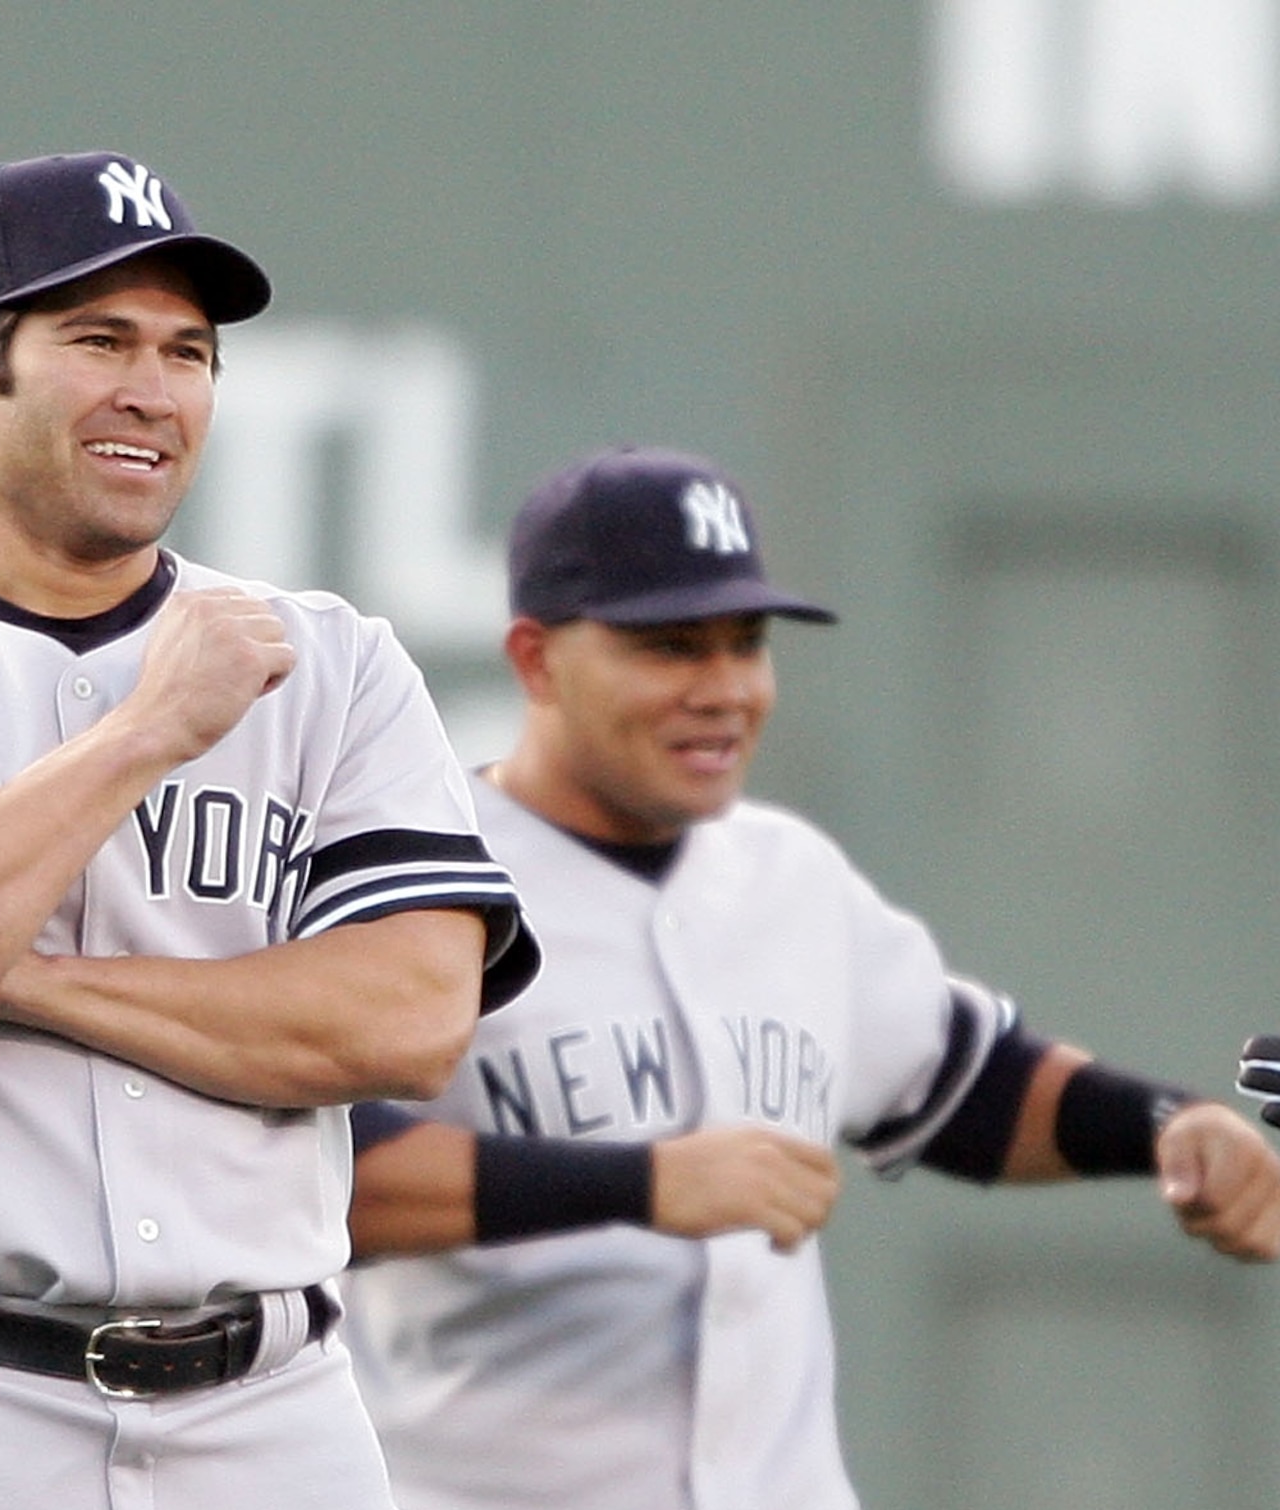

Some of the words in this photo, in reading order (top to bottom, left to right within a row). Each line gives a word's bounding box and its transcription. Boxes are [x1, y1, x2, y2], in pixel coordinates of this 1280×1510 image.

[99, 161, 173, 231] NY
[681, 481, 749, 554] NY
[475, 1015, 682, 1138] NEW
